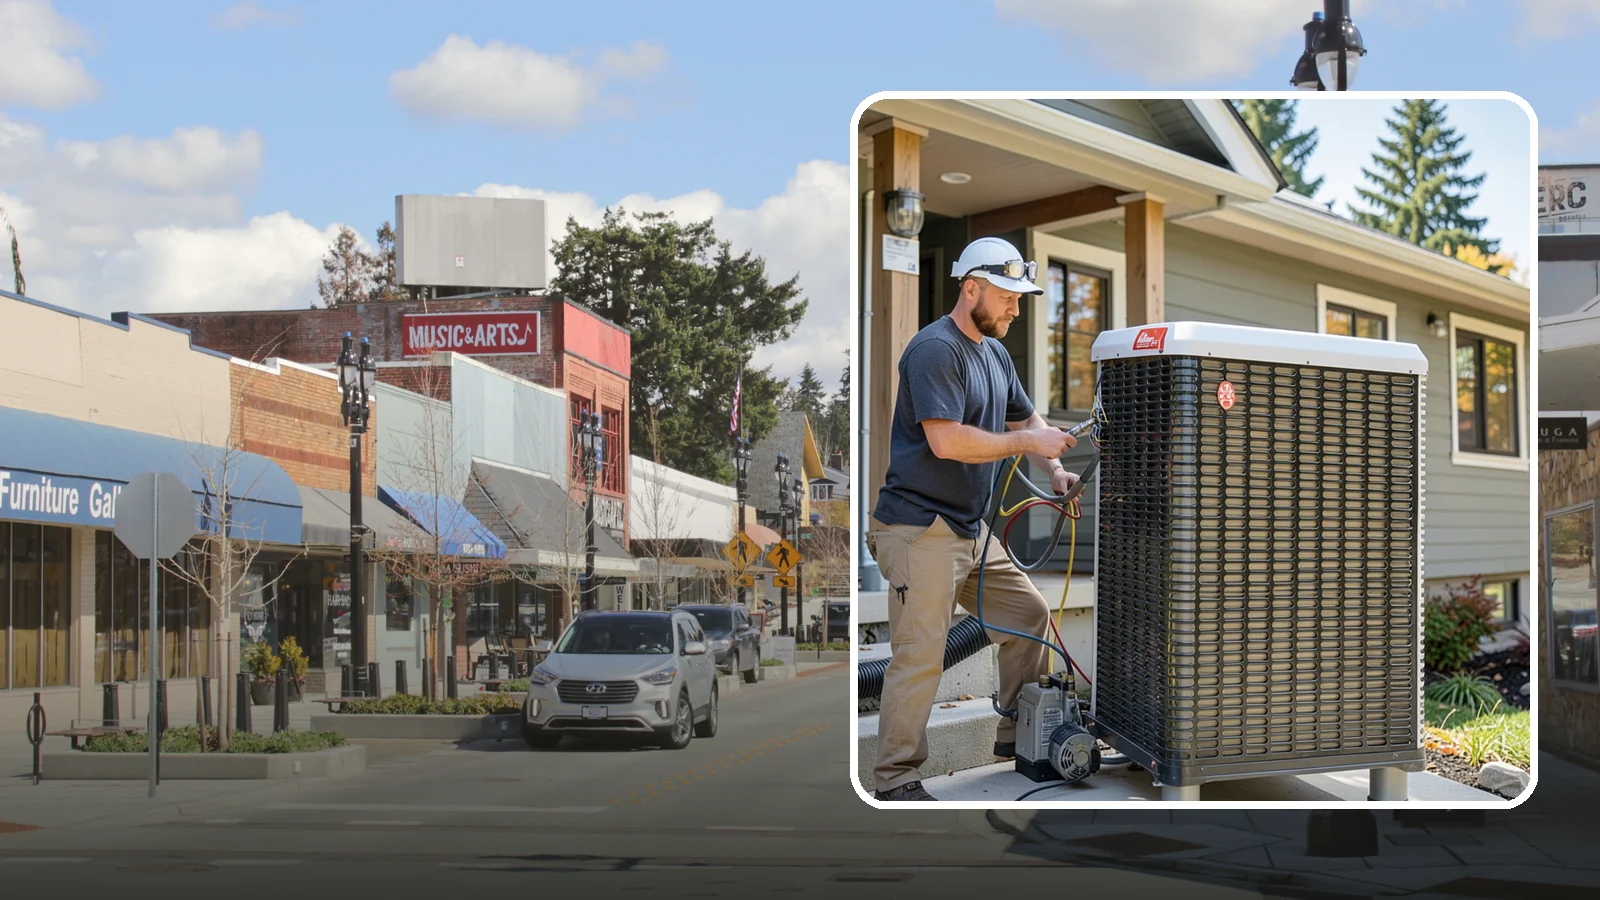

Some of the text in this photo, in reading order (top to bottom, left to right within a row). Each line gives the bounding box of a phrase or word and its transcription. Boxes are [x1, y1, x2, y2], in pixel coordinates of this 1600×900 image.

[408, 322, 519, 348] MUSIC&ARTS
[1540, 427, 1577, 437] UGA
[0, 472, 79, 515] Furniture
[453, 563, 479, 574] SUSHI
